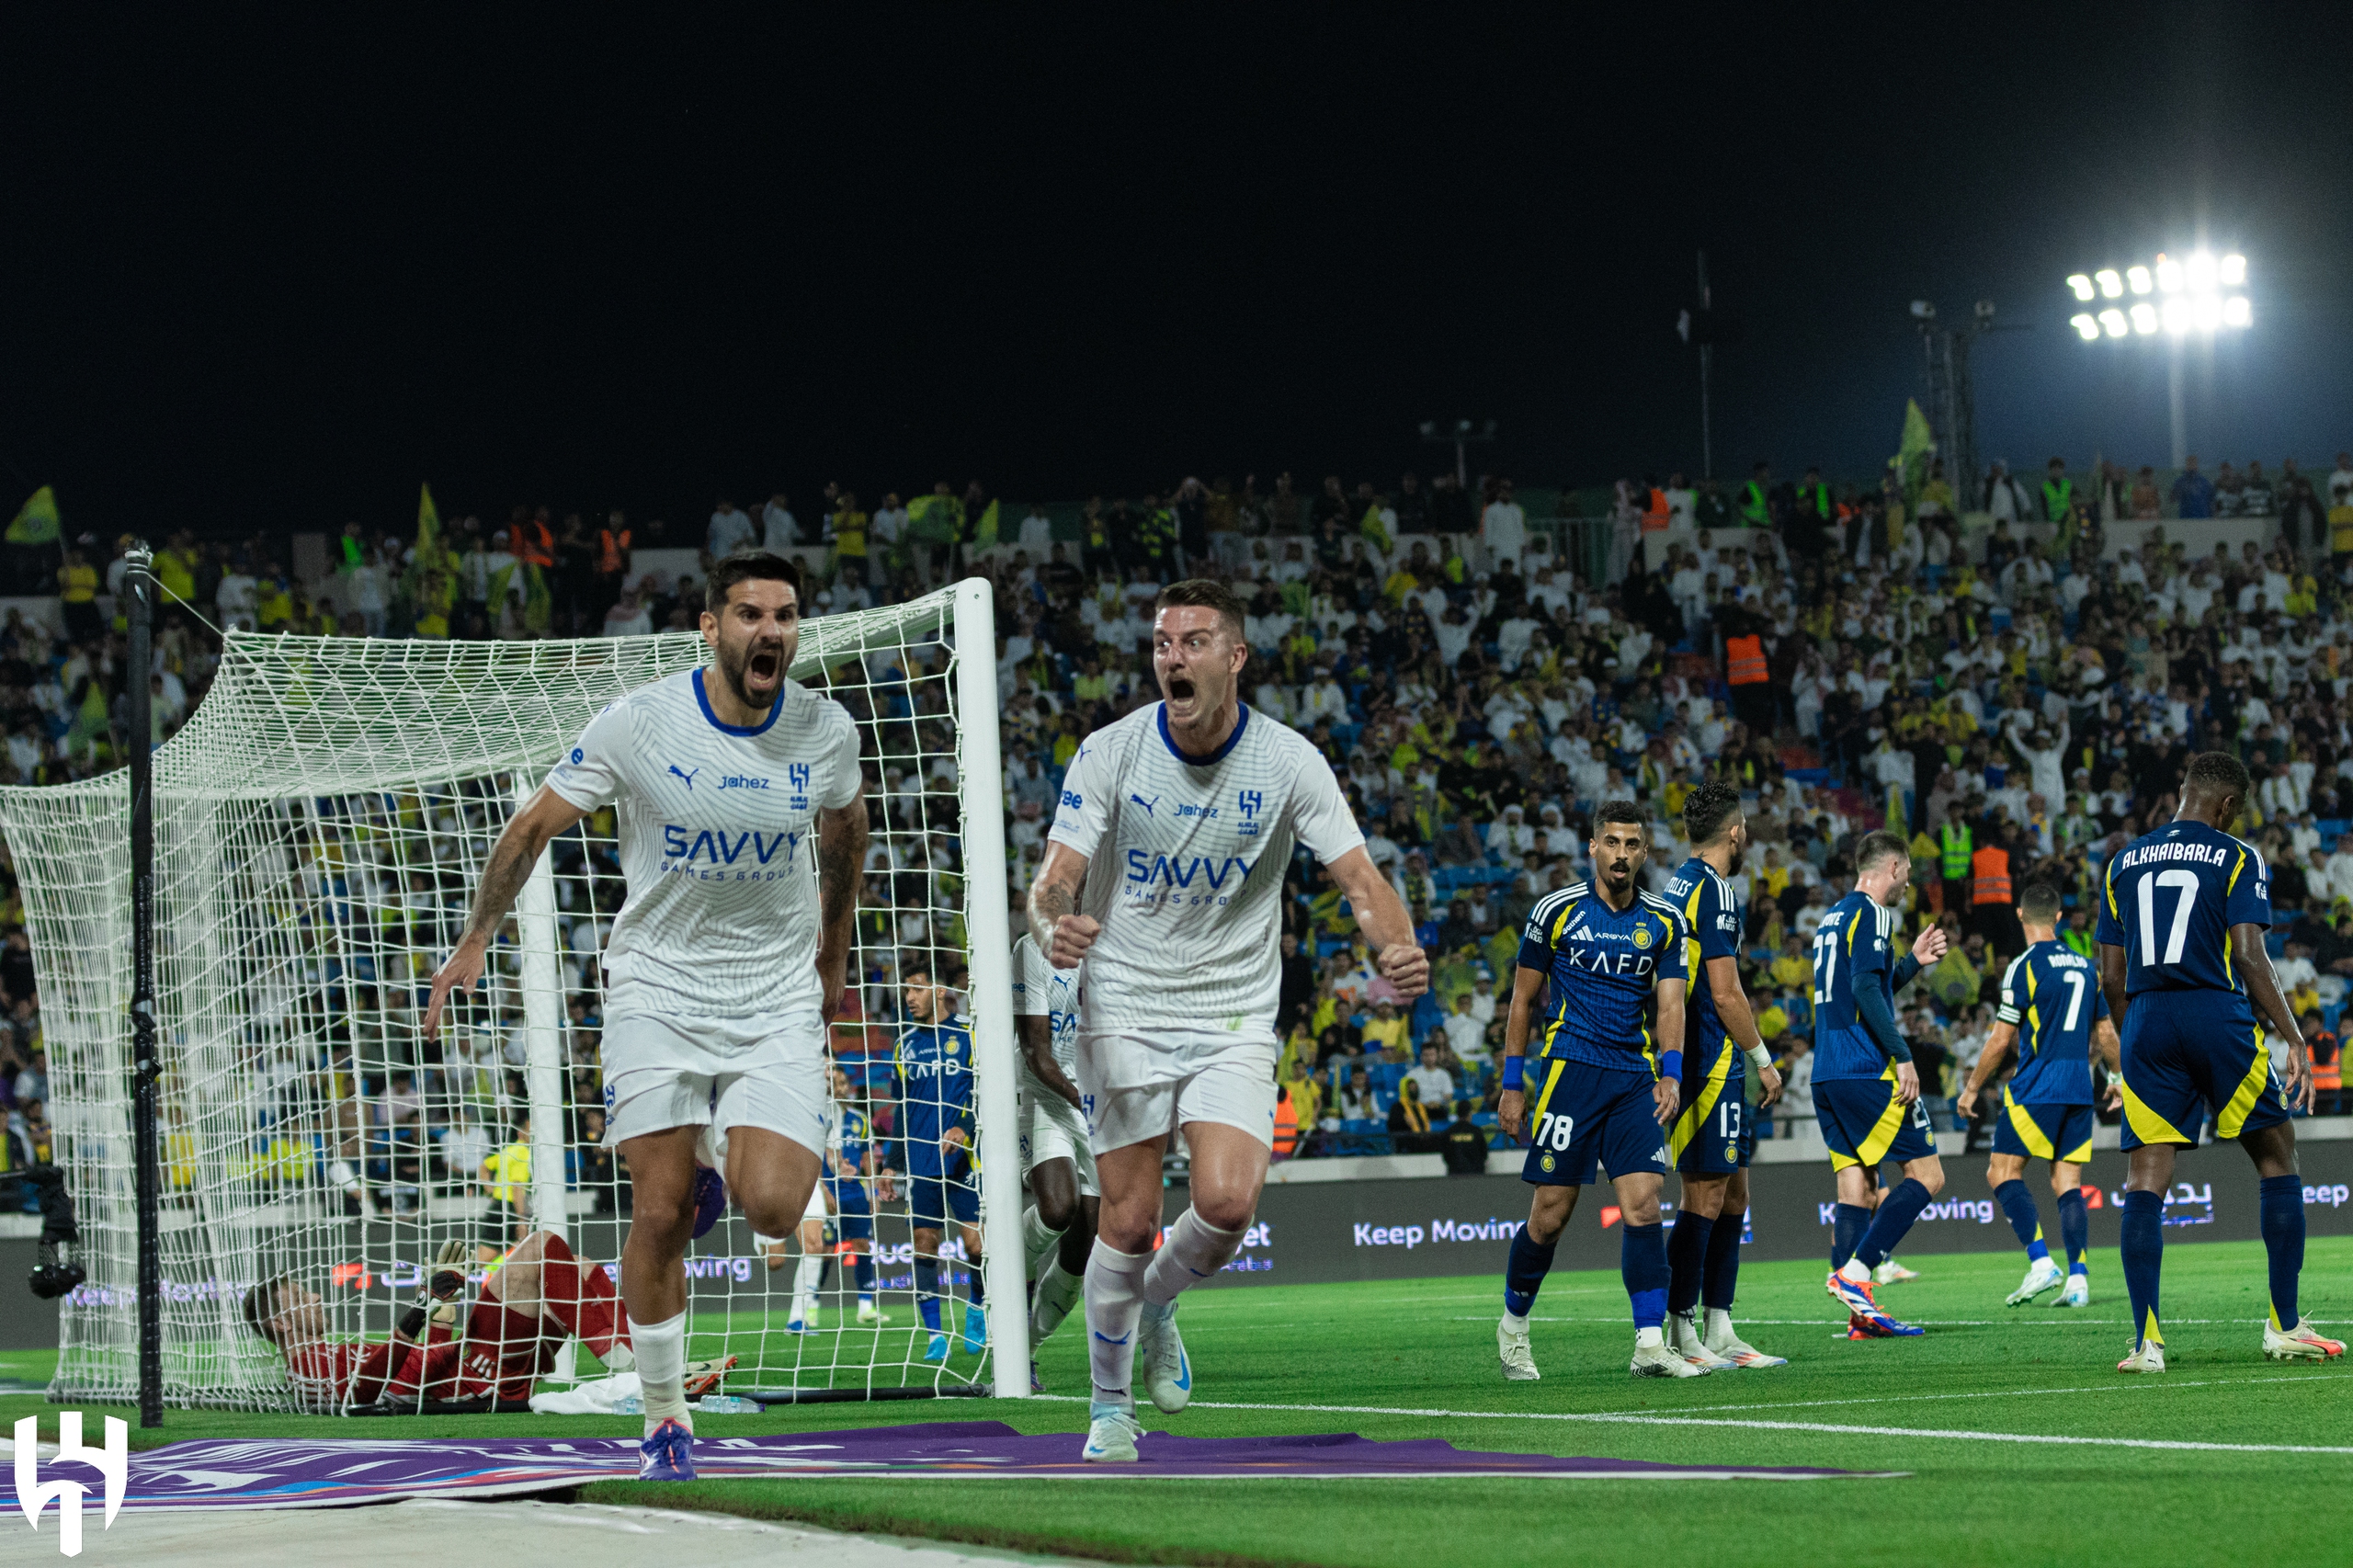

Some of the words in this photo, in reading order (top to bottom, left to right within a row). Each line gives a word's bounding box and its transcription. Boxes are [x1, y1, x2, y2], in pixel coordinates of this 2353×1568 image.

[665, 824, 806, 864] SAVVY
[660, 861, 724, 881] GAMES
[736, 867, 794, 881] GROUP
[1128, 848, 1259, 890] SAVVY
[1125, 885, 1180, 903] GAMES
[2137, 869, 2200, 966] 17
[1570, 948, 1653, 976] KAFD
[1813, 931, 1837, 1005] 27
[2063, 970, 2086, 1031] 7
[1536, 1112, 1574, 1152] 78
[1720, 1102, 1741, 1138] 13
[1915, 1196, 1995, 1224] oving
[2302, 1184, 2349, 1209] eep
[1354, 1221, 1425, 1250] Keep
